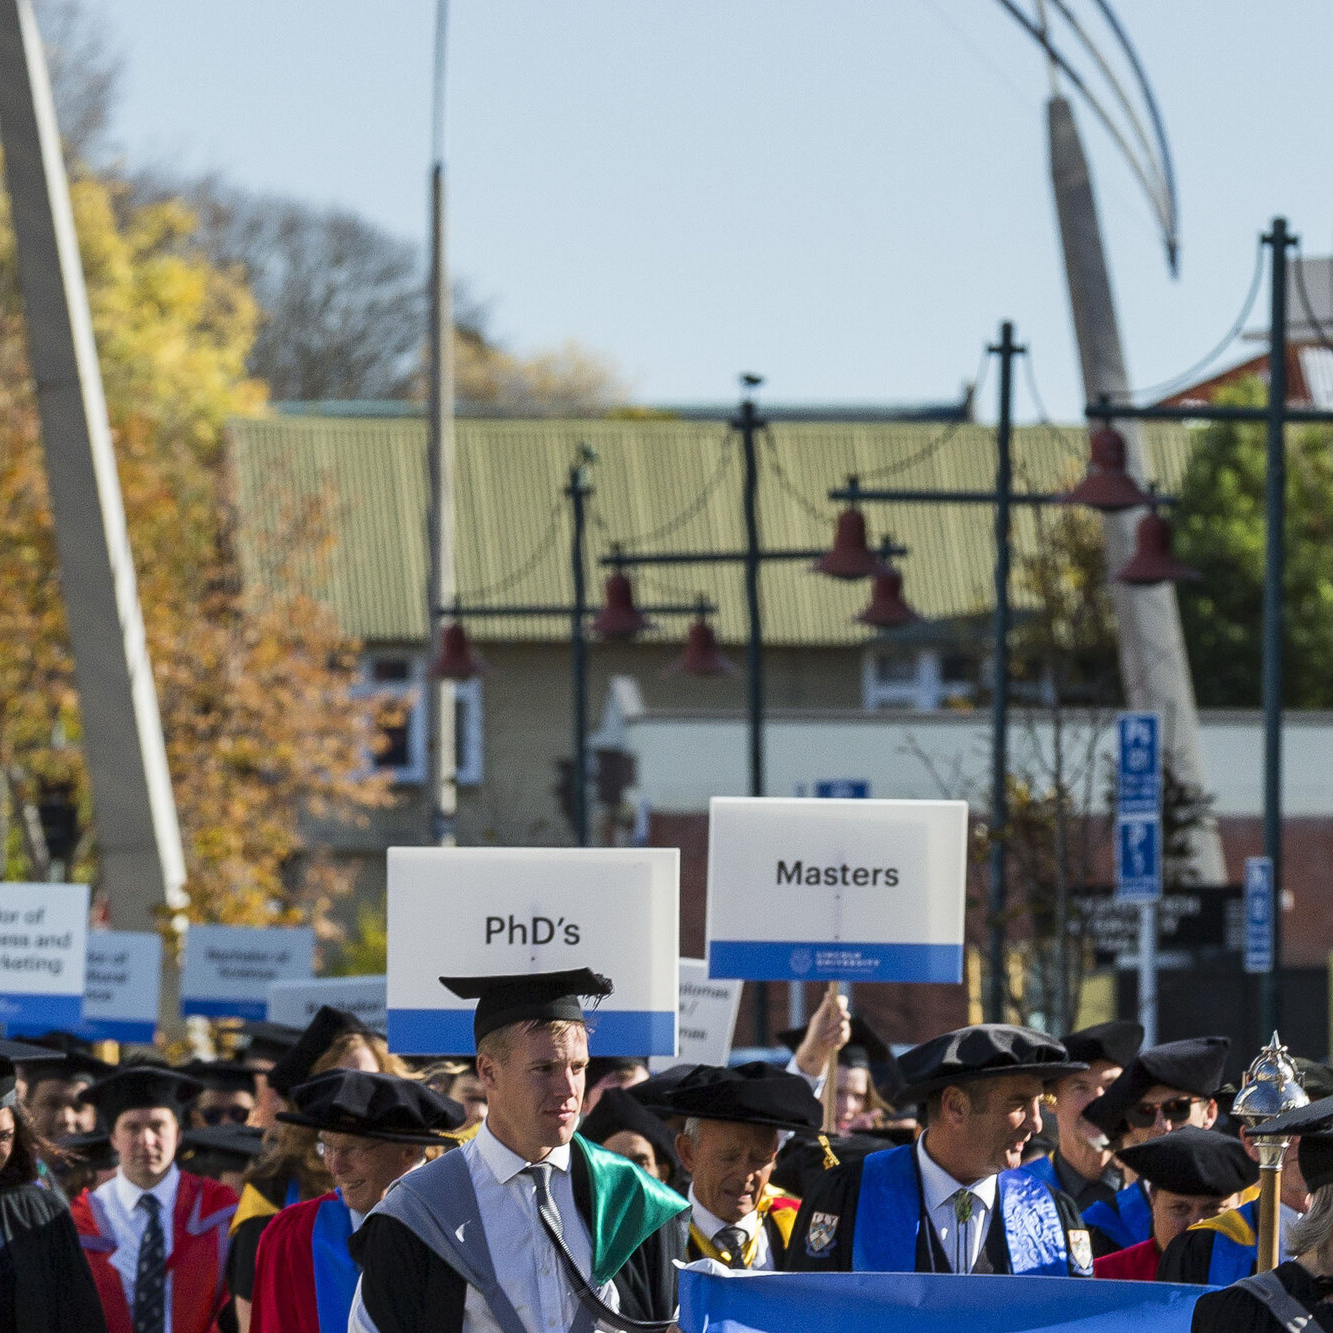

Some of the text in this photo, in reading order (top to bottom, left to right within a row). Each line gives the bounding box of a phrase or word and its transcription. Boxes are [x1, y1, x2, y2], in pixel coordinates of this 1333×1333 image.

[776, 860, 900, 887] Masters
[24, 906, 45, 924] of
[35, 932, 72, 949] and
[485, 914, 581, 946] PhD's
